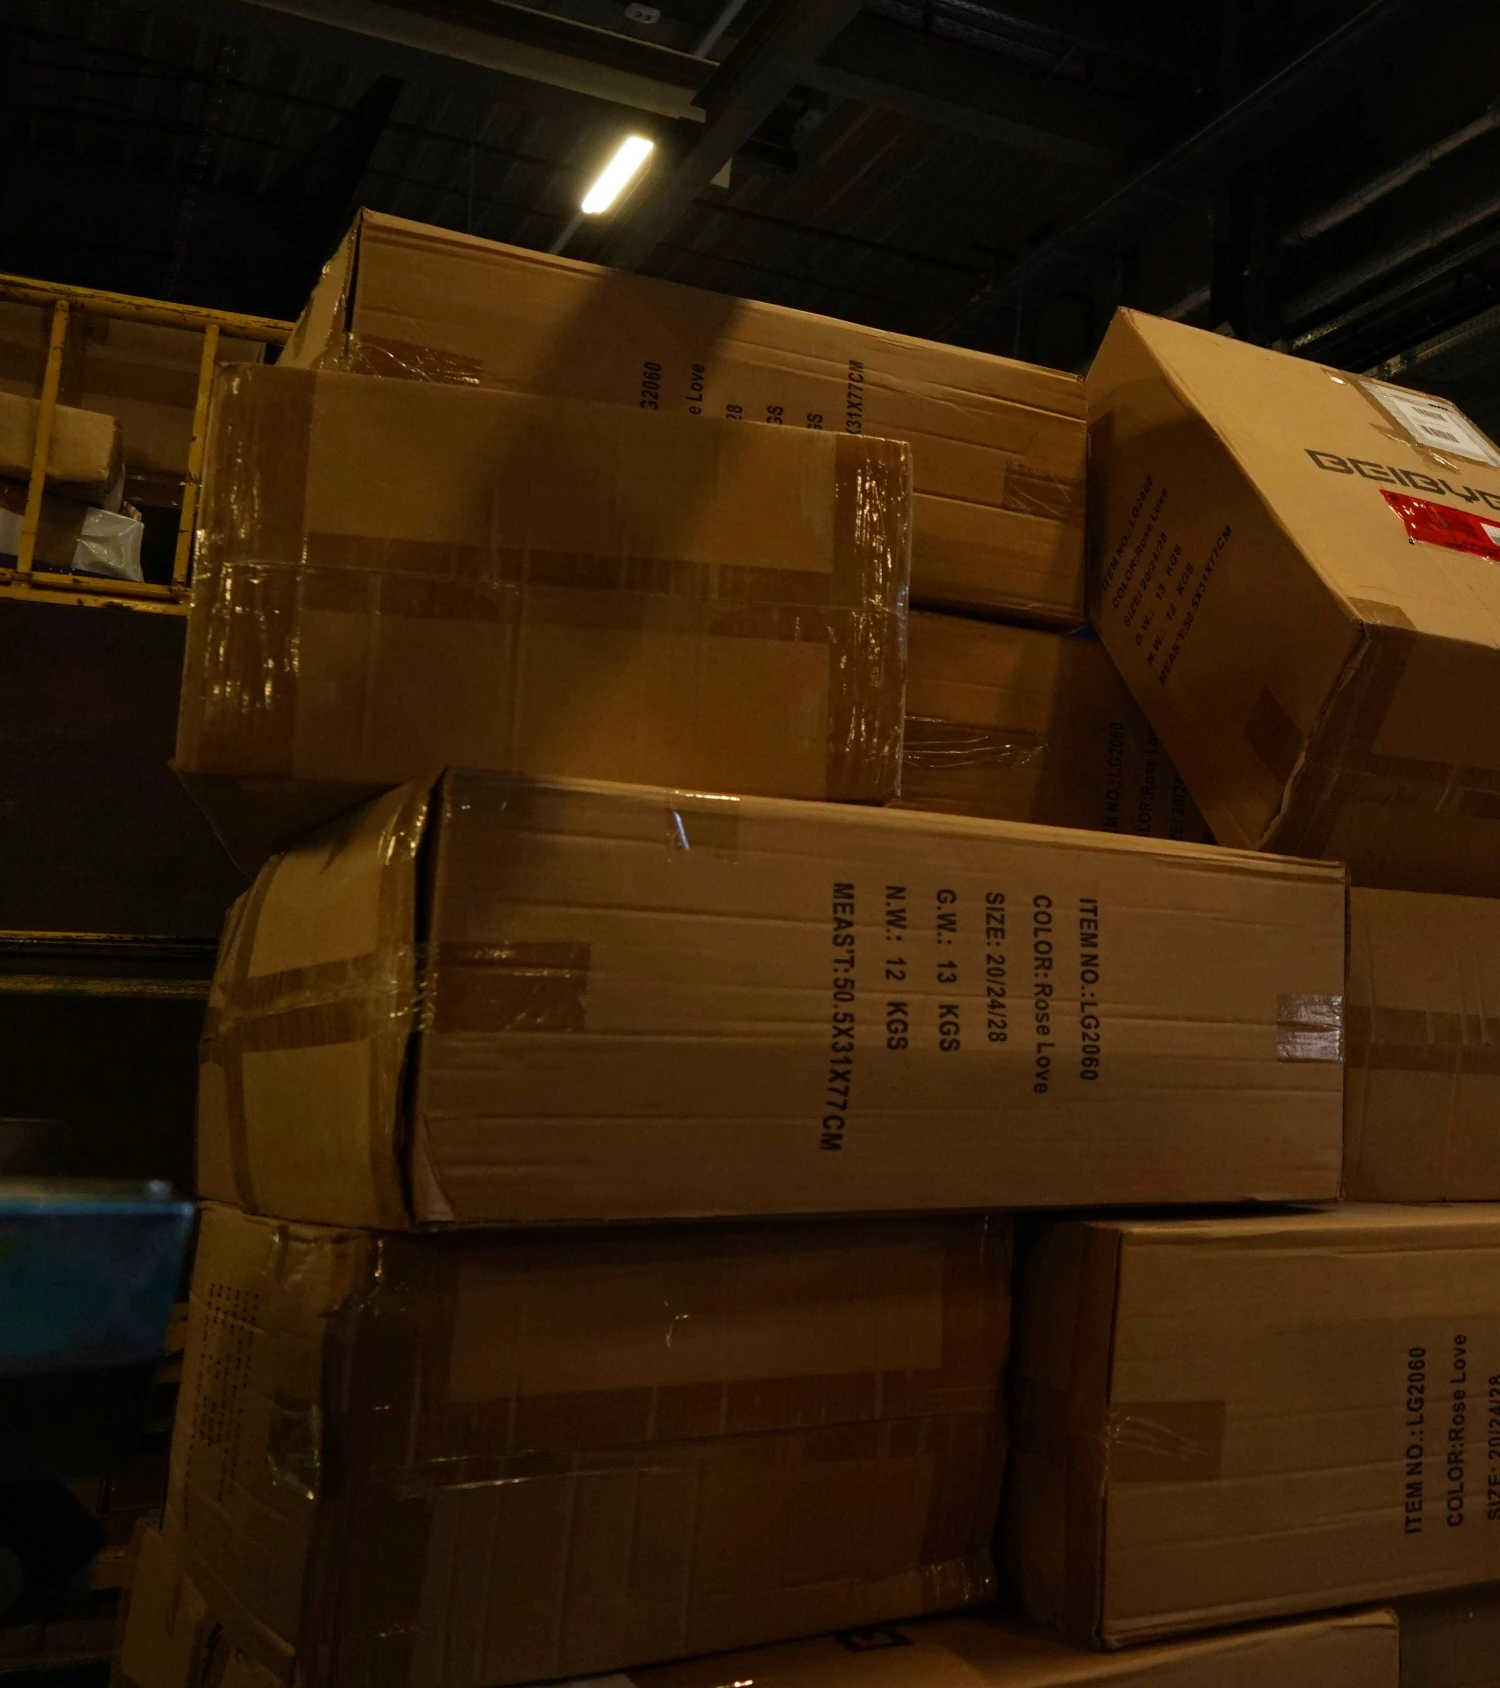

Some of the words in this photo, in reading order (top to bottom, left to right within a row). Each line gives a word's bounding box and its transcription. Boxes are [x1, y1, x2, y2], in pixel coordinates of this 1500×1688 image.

[685, 363, 705, 402] Love
[1150, 488, 1168, 522] Love
[1101, 556, 1119, 592] ITEM
[1124, 590, 1144, 628] SIZE:
[1142, 532, 1168, 591] 20/24/28
[1156, 583, 1166, 601] 13
[1165, 543, 1182, 577] KGS
[1166, 603, 1177, 621] 12
[1176, 562, 1194, 596] KGS
[885, 885, 907, 941] N.W.:
[936, 888, 958, 946] G.W.:
[985, 891, 1006, 947] SIZE:
[1079, 897, 1099, 948] ITEM
[885, 957, 907, 981] 12
[936, 960, 958, 984] 13
[986, 953, 1008, 1043] 20/24/28
[886, 1001, 909, 1051] KGS
[938, 1004, 960, 1053] KGS
[1033, 1042, 1056, 1095] Love
[1450, 1333, 1467, 1384] Love
[1405, 1481, 1423, 1535] ITEM
